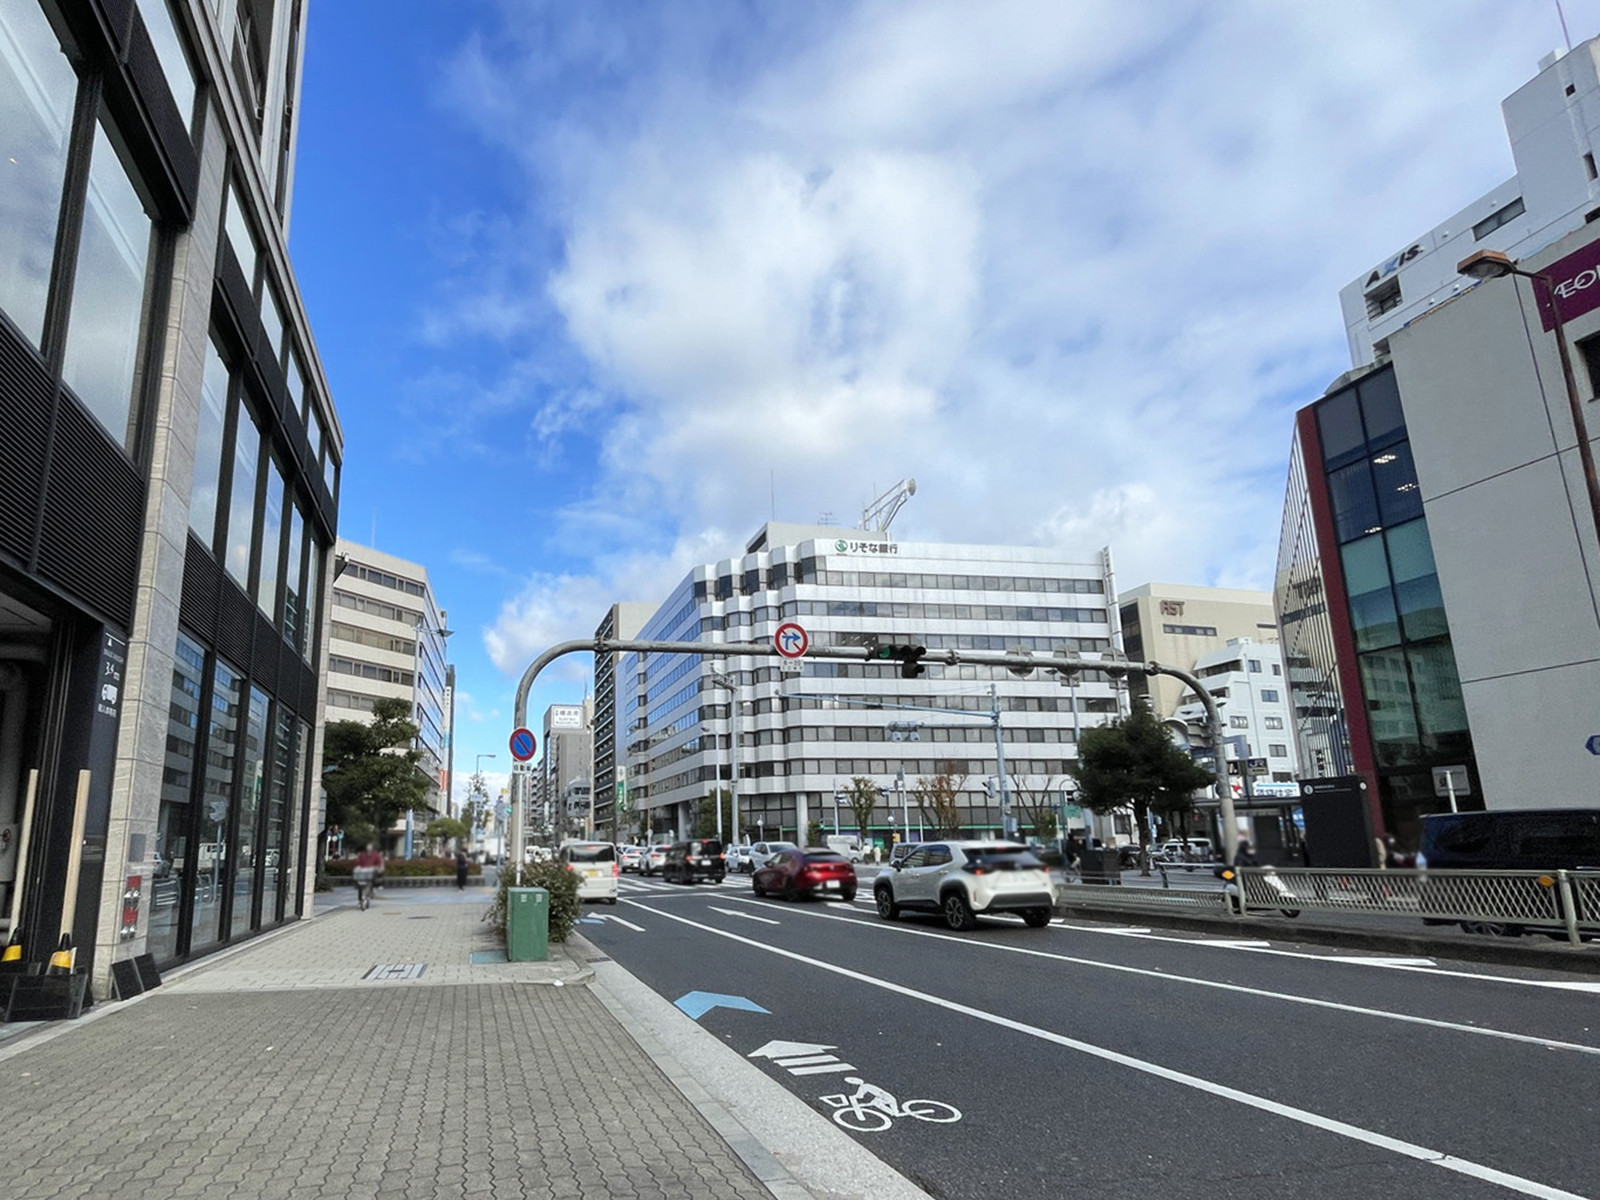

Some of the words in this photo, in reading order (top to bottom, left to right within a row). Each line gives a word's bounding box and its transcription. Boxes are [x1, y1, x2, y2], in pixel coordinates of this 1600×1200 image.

[1365, 244, 1421, 288] AXIS
[1554, 265, 1600, 298] AEO
[850, 541, 898, 555] りそな銀行
